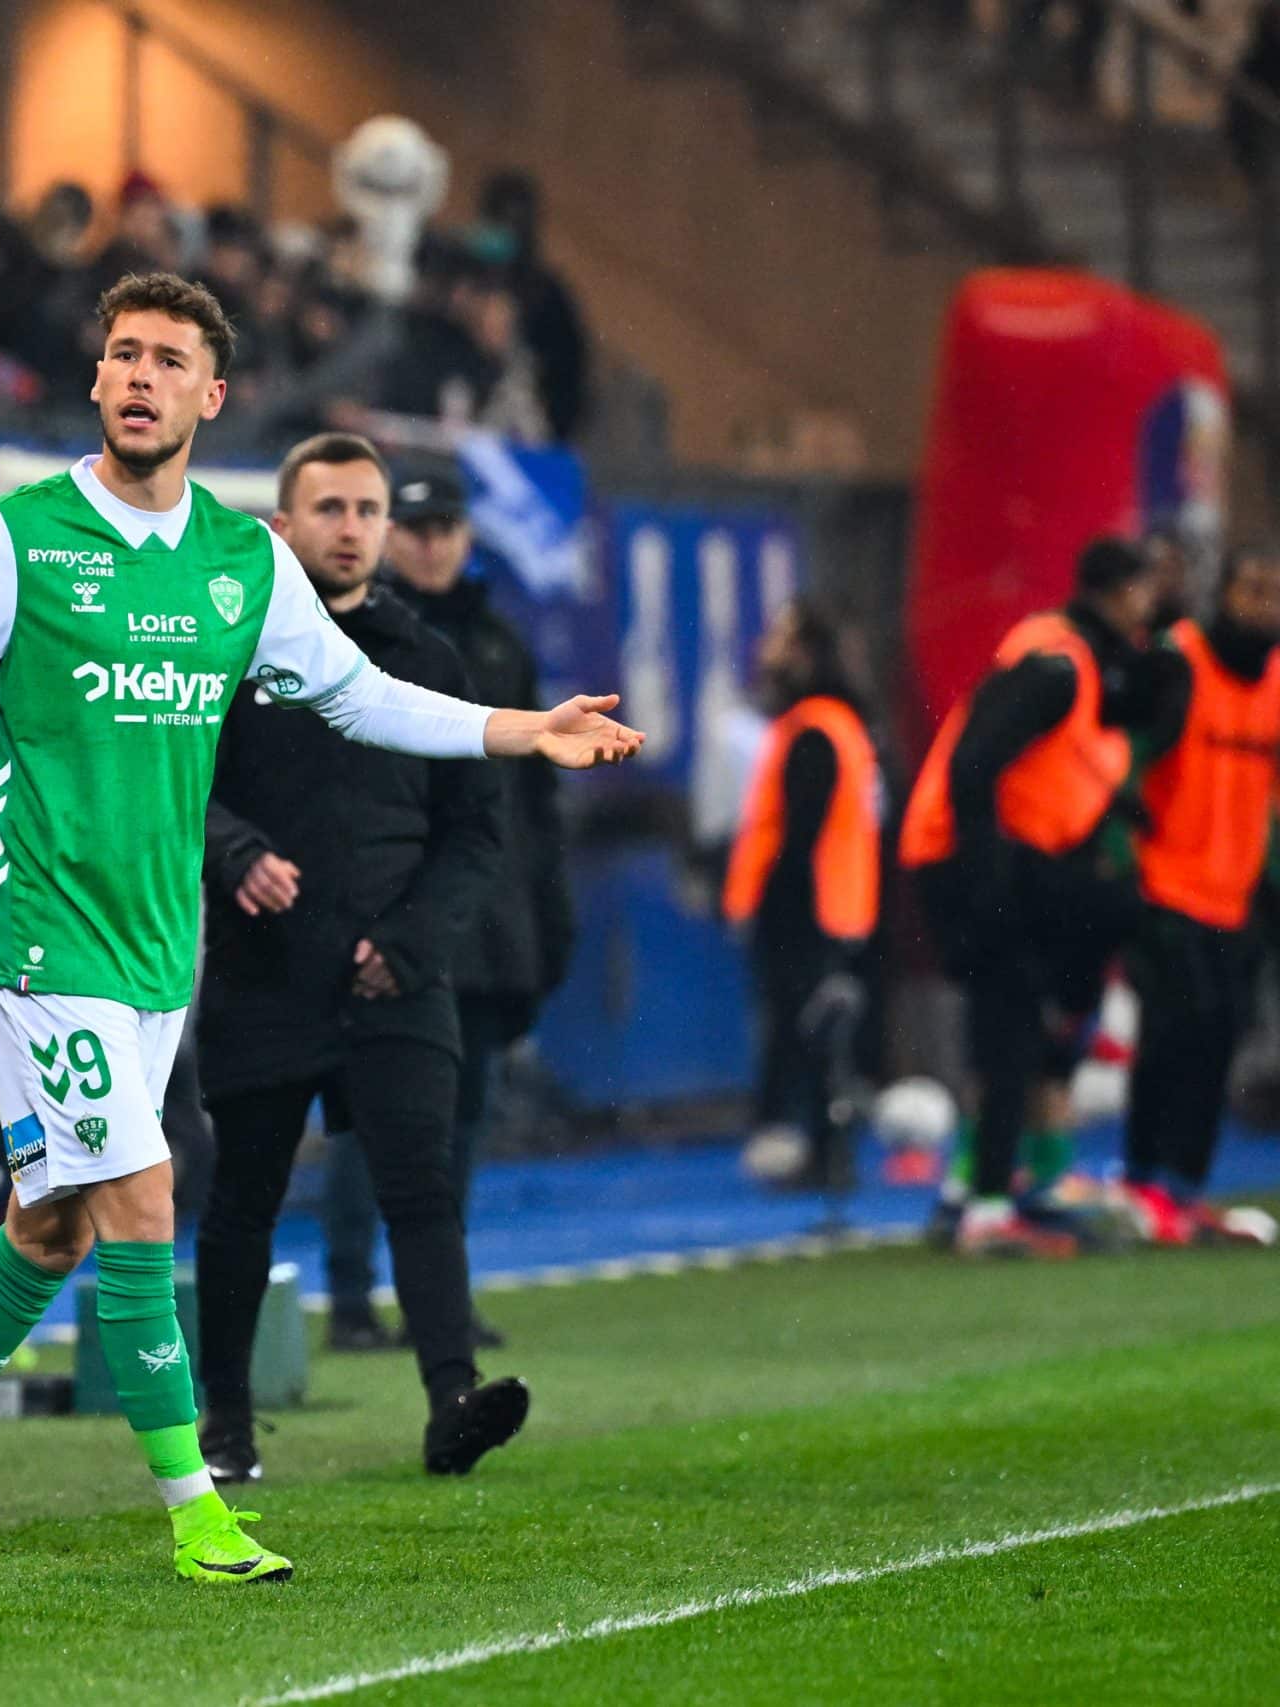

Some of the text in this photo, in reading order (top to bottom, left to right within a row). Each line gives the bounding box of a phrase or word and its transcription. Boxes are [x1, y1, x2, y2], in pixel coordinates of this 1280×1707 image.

[78, 565, 115, 577] LOIRE
[129, 633, 198, 643] LE DÉPARTEMENT
[111, 661, 228, 711] Kelyps
[153, 713, 202, 726] INTERIM
[67, 1029, 112, 1100] 9
[76, 1119, 104, 1132] ASSE
